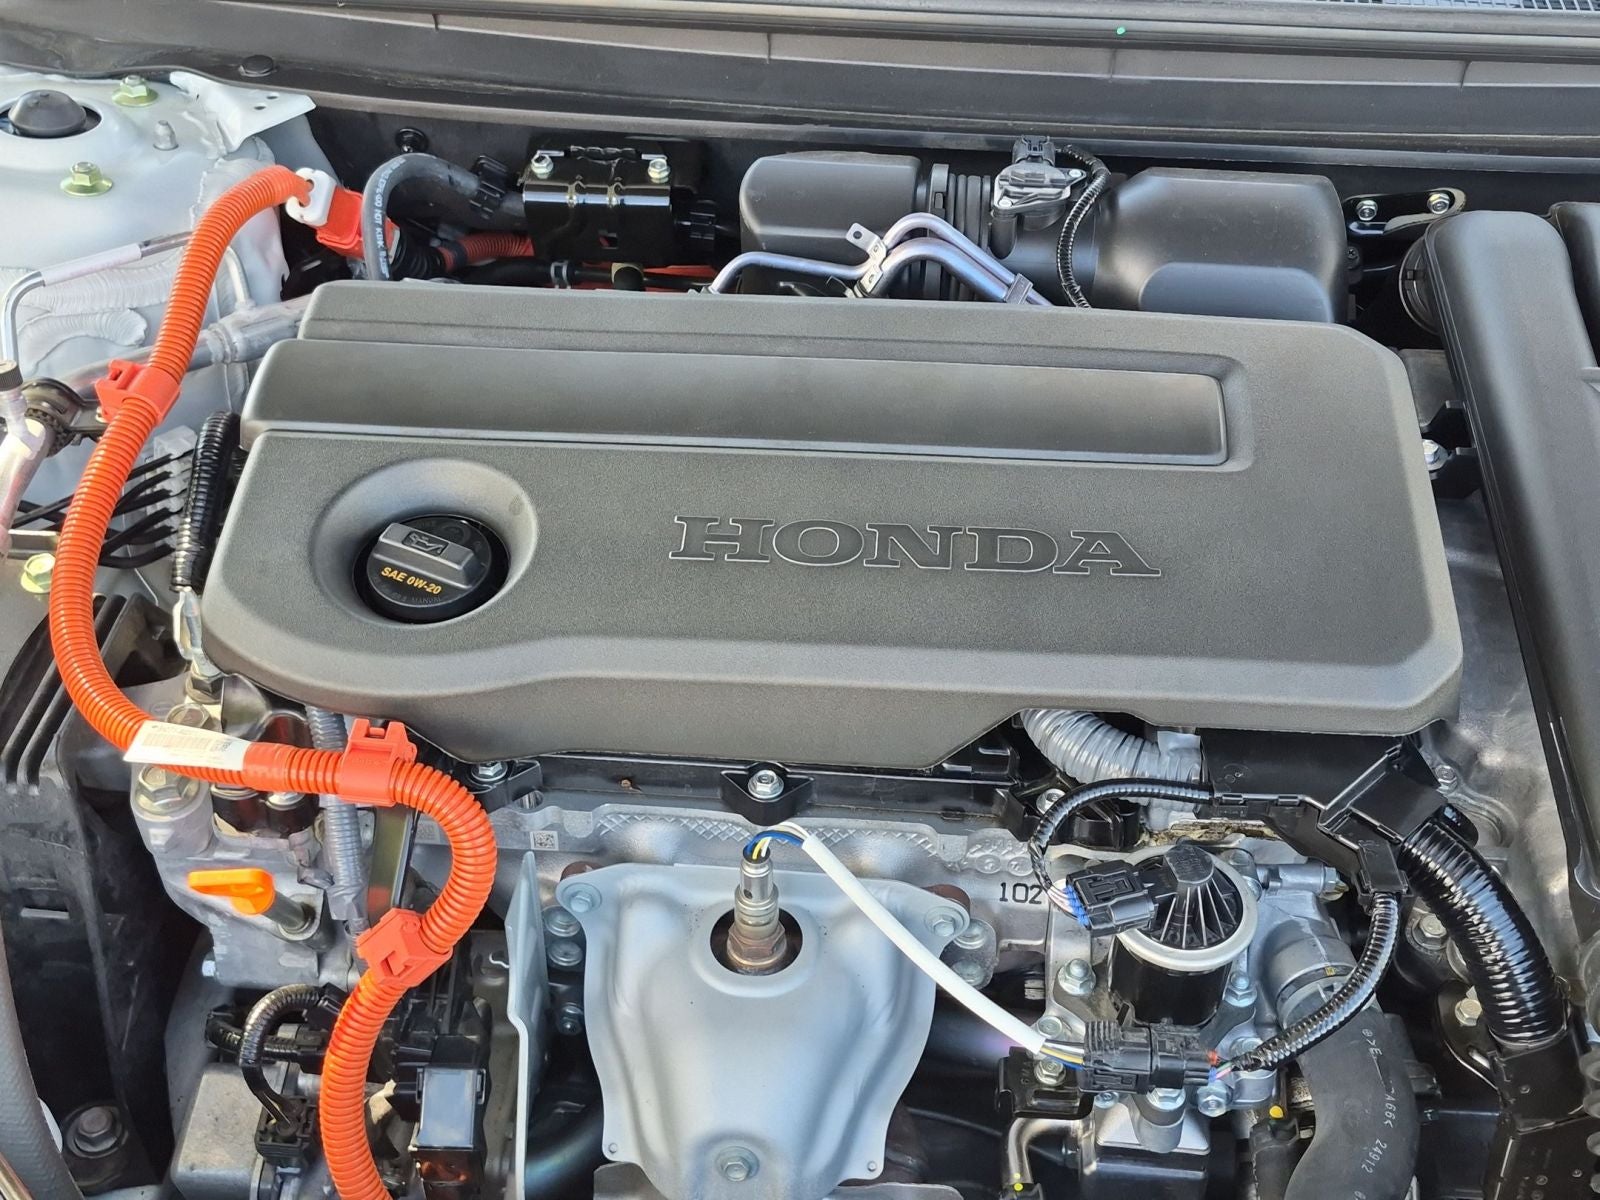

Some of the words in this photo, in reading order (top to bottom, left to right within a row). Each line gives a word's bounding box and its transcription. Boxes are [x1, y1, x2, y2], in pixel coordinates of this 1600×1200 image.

[669, 515, 1161, 577] HONDA
[380, 567, 407, 582] SAE
[407, 576, 442, 594] 0W-20
[999, 882, 1043, 905] 102
[1361, 1138, 1388, 1174] 24912
